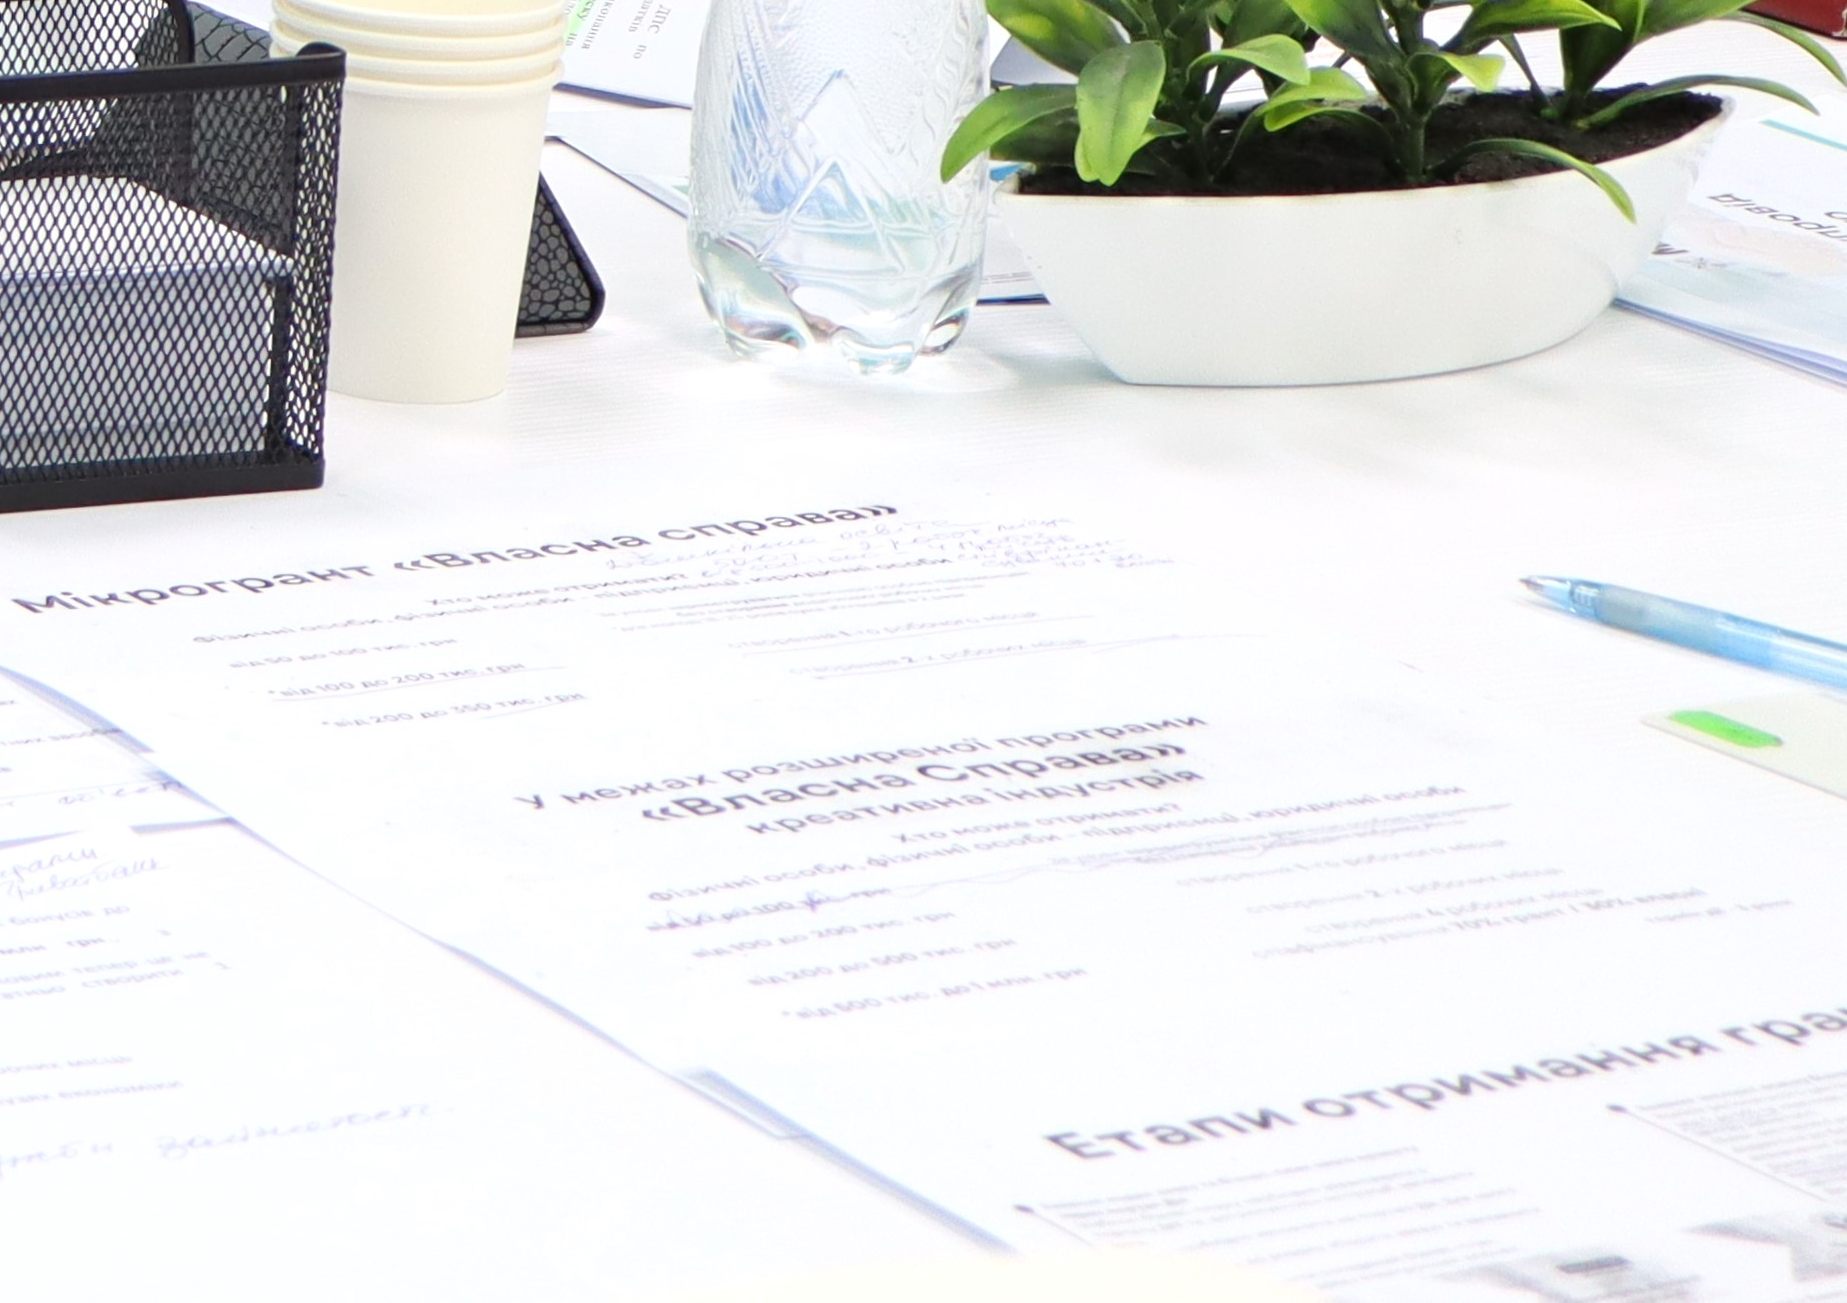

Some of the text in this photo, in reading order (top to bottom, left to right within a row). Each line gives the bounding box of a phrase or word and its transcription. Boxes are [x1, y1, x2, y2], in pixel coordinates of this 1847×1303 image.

[644, 3, 672, 37] ДПС
[631, 42, 647, 61] по
[11, 502, 899, 614] Мікрогрант «Власна справа»
[424, 594, 471, 609] Хто
[476, 585, 551, 604] може
[316, 679, 355, 695] 100
[392, 670, 435, 685] 200
[485, 660, 526, 677] грн
[370, 711, 413, 726] 200
[543, 690, 587, 706] грн
[561, 771, 711, 807] межах
[727, 735, 992, 787] розширеної
[997, 713, 1208, 752] програми
[641, 741, 1187, 823] «Власна Справа»
[746, 787, 994, 836] креативна
[1000, 765, 1205, 808] індустрія
[892, 827, 948, 846] Хто
[952, 817, 1031, 838] може
[1041, 1006, 1847, 1160] Етапи отримання гра
